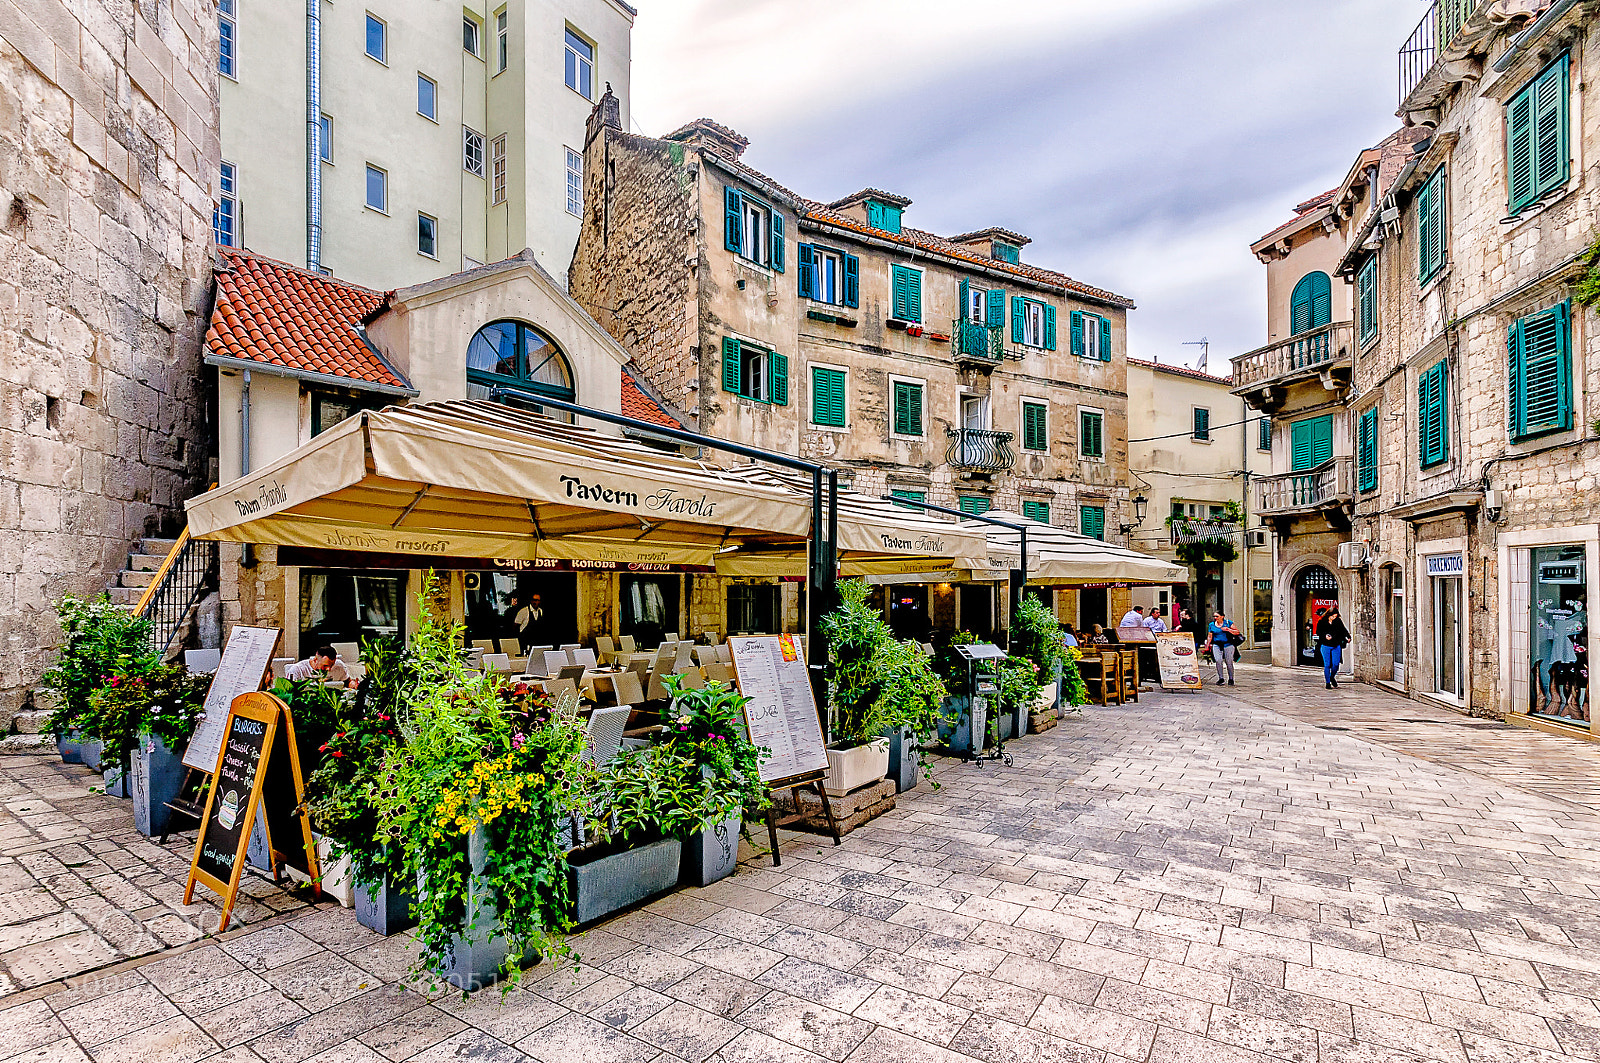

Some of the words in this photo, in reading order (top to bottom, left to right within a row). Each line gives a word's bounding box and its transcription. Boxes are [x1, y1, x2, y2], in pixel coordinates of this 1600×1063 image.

[559, 474, 639, 507] Tavern
[644, 488, 717, 517] Favola
[233, 499, 261, 517] Tavern
[880, 534, 912, 550] Tavern
[233, 717, 263, 735] BURGERS:
[203, 842, 218, 859] Good
